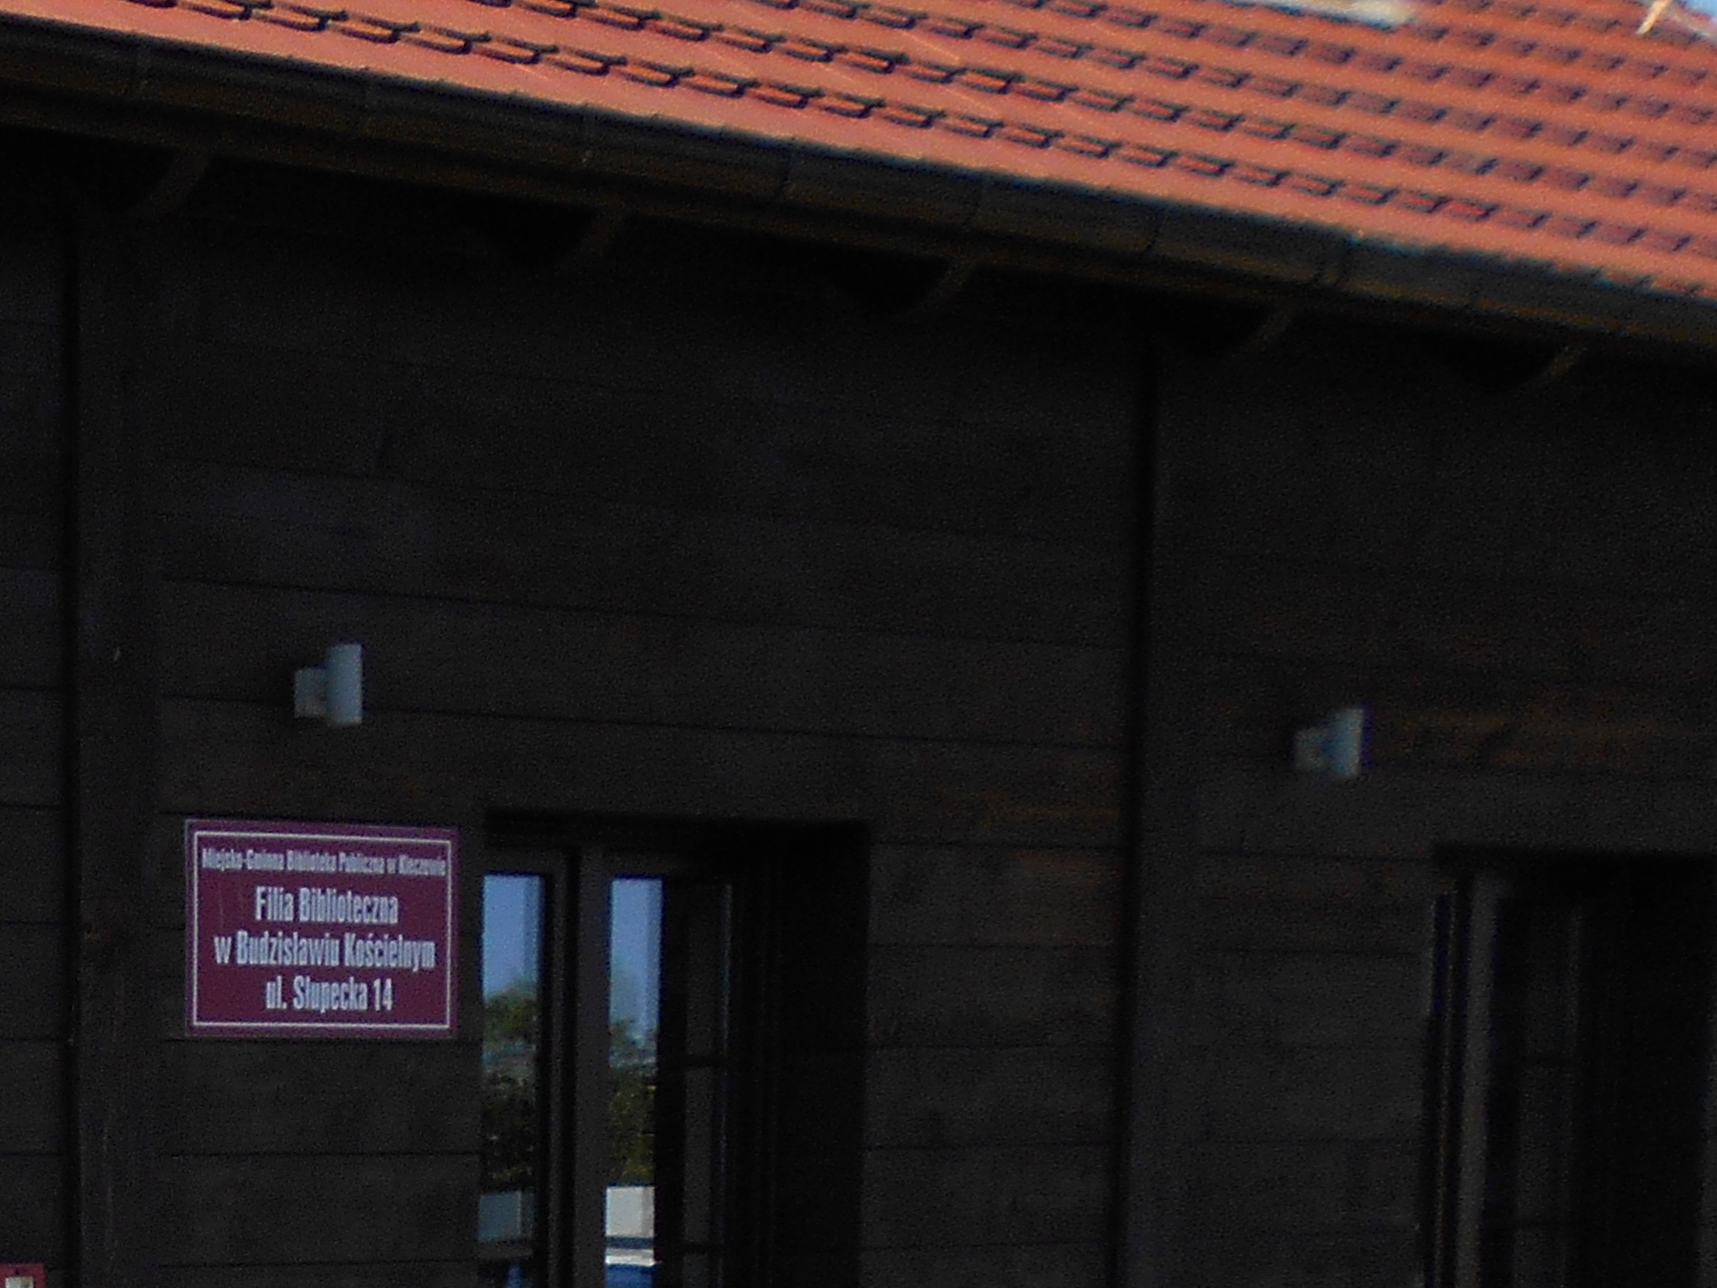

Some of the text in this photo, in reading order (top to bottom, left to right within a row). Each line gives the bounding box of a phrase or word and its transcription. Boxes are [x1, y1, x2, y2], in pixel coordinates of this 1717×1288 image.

[255, 886, 399, 925] Filia Biblioteczna
[214, 931, 436, 972] w Budzisławiu Kościelnym
[266, 975, 393, 1013] ul. Słupecka 14
